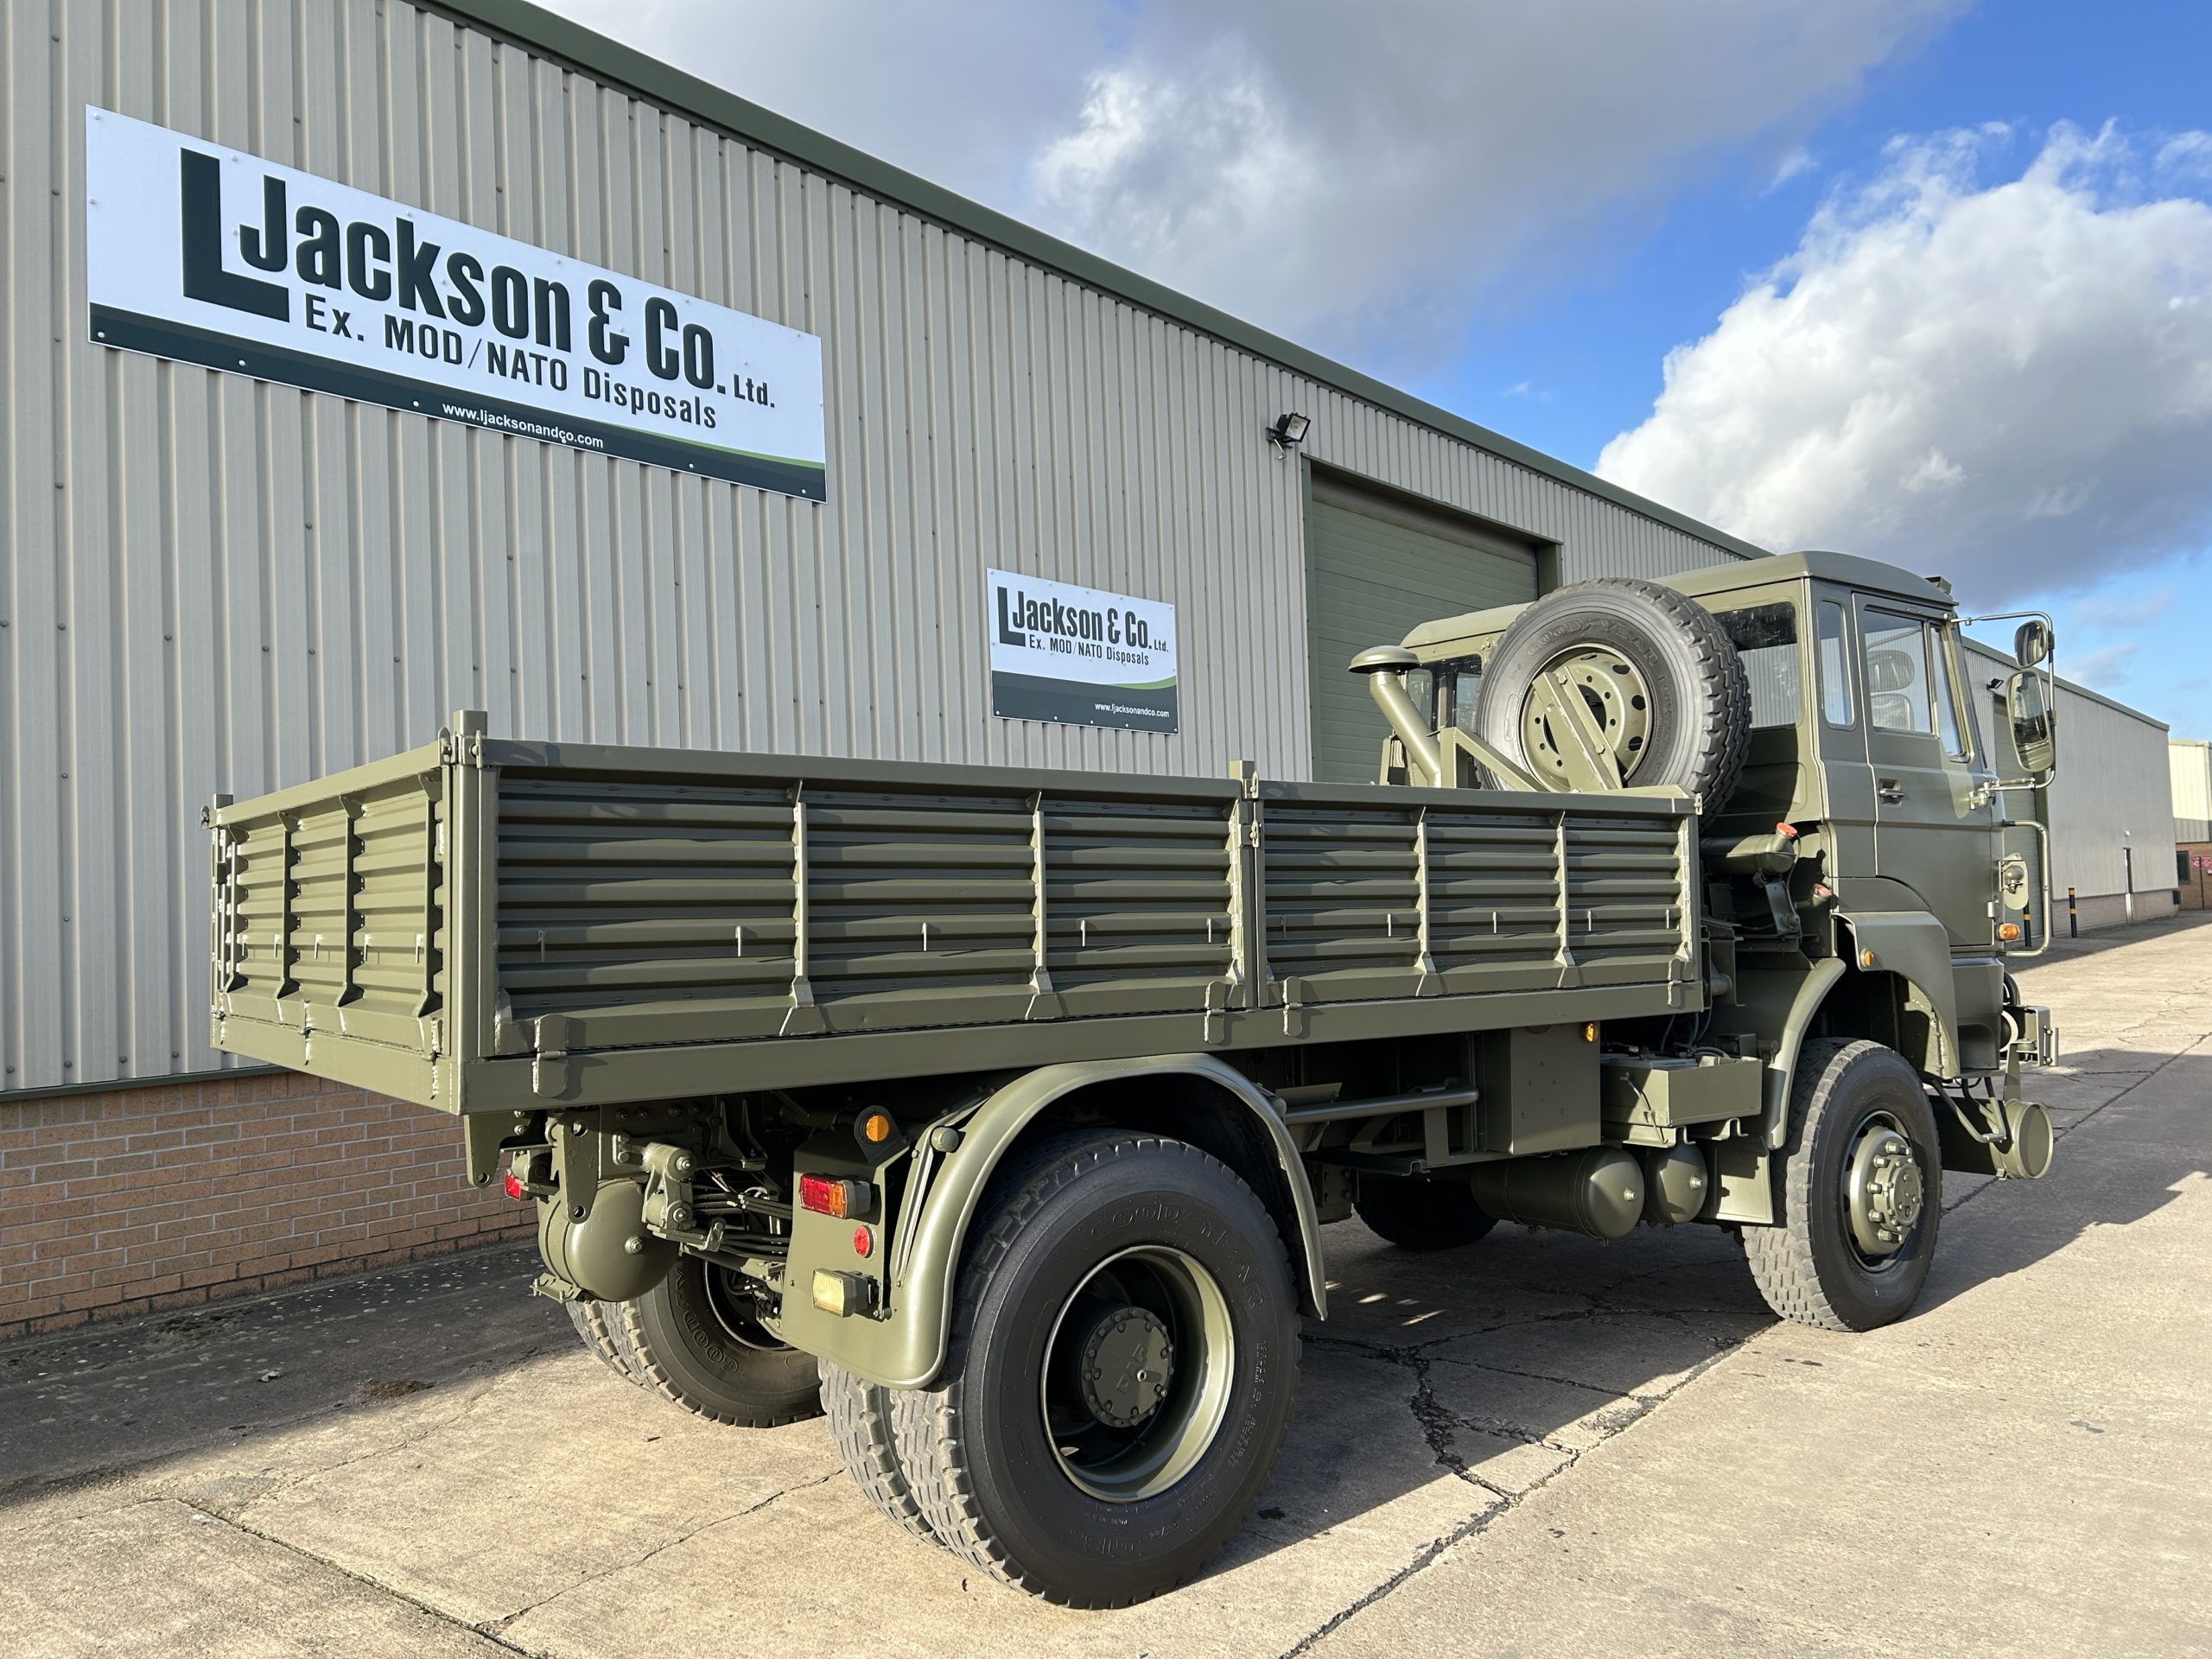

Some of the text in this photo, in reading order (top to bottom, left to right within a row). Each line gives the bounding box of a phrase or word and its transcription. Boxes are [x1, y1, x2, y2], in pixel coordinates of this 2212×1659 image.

[304, 292, 716, 429] Ex. MOD/NATO Disposals
[588, 278, 630, 365] &
[645, 296, 726, 395] Co.
[734, 372, 776, 409] Ltd.
[442, 401, 604, 449] www.ljacksonandco.com
[1029, 634, 1149, 666] Ex. MOD/NATO Disposals
[1107, 607, 1121, 645] &
[1125, 610, 1153, 650] Co.
[1154, 639, 1169, 652] Ltd.
[1094, 702, 1170, 718] www.ljacksonandco.com
